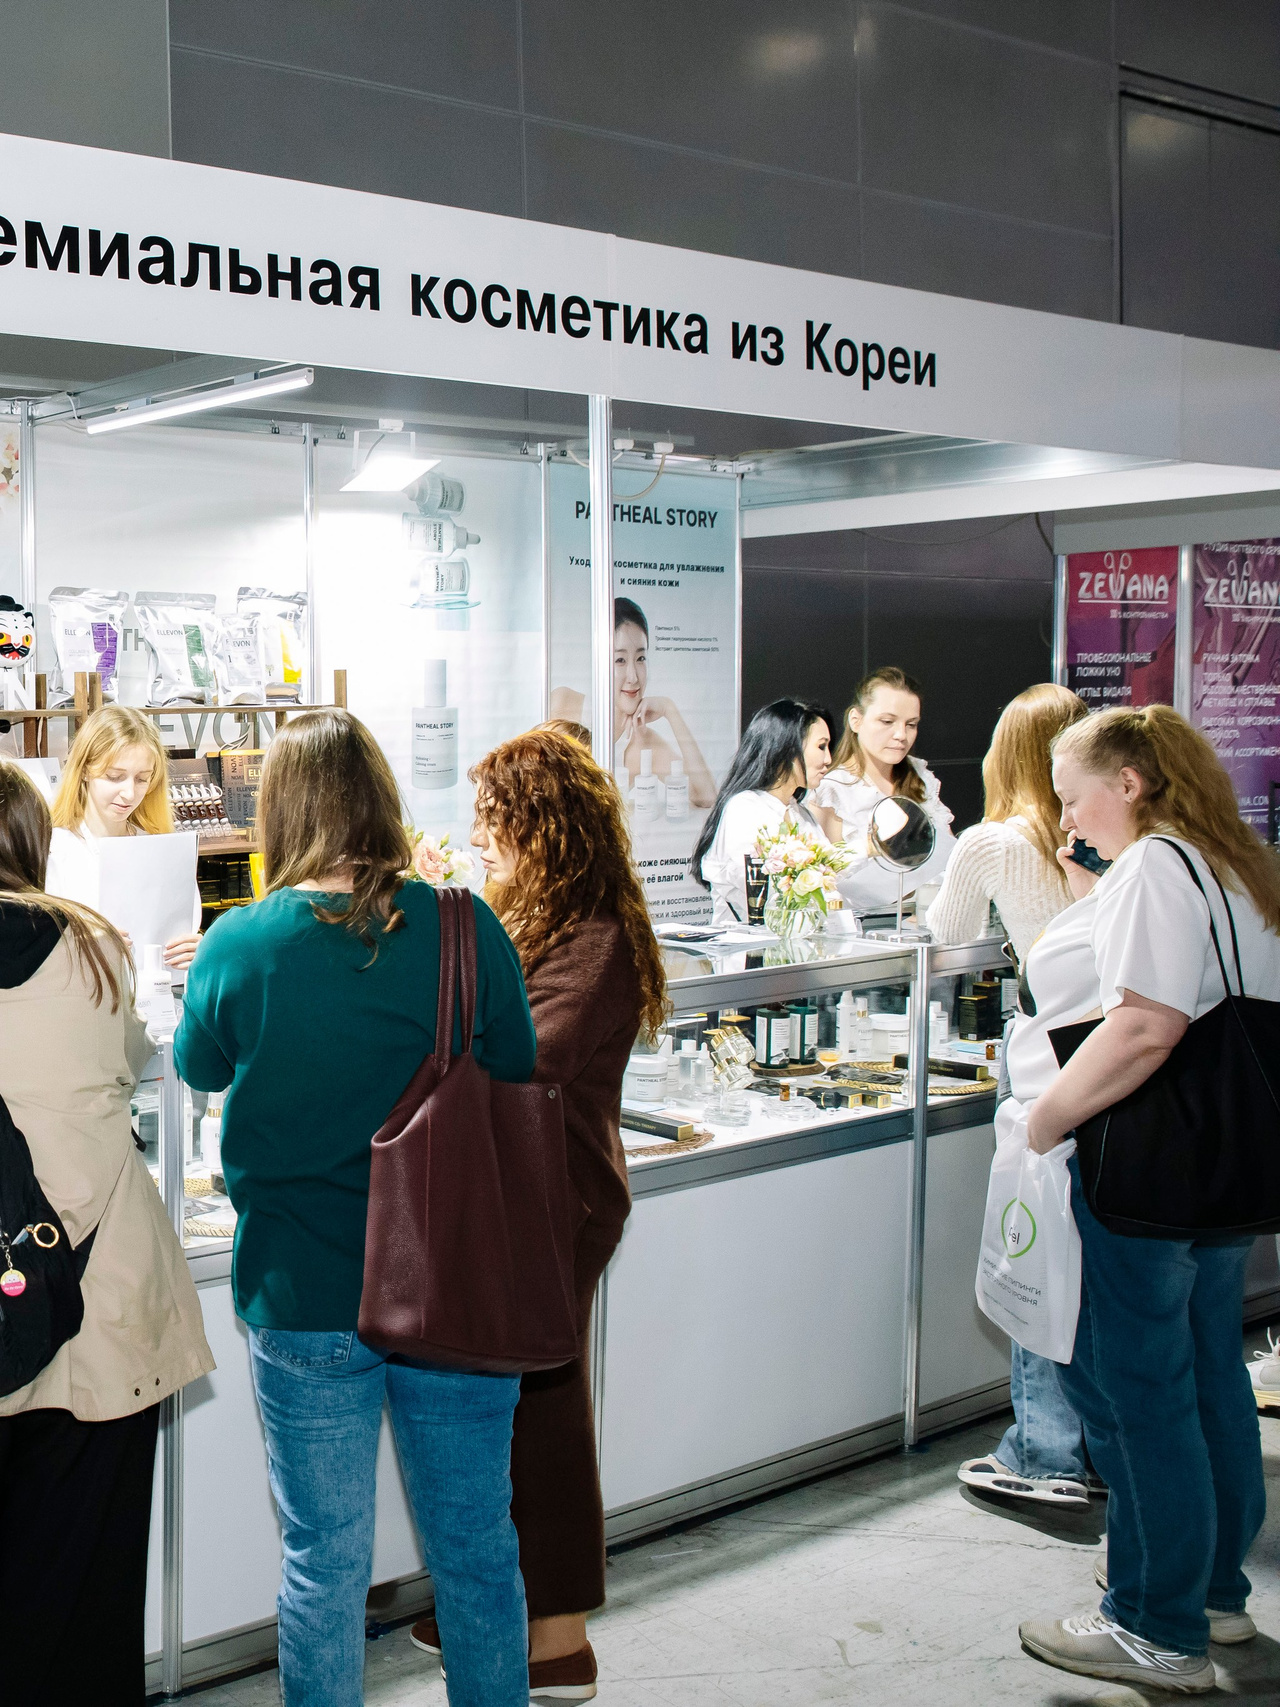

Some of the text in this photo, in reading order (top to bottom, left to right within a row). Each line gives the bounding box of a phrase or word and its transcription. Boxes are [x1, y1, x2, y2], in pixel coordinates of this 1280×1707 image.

[409, 272, 709, 356] косметика
[731, 320, 784, 367] из
[805, 318, 938, 392] Кореи
[575, 500, 718, 529] PTHEAL STORY
[613, 560, 658, 570] косметика
[659, 561, 675, 572] для
[676, 562, 726, 574] увлажнения
[620, 577, 680, 588] и сияния кожи
[638, 856, 693, 868] коже сияющи
[646, 872, 684, 883] её влагой
[670, 907, 702, 917] здоровый
